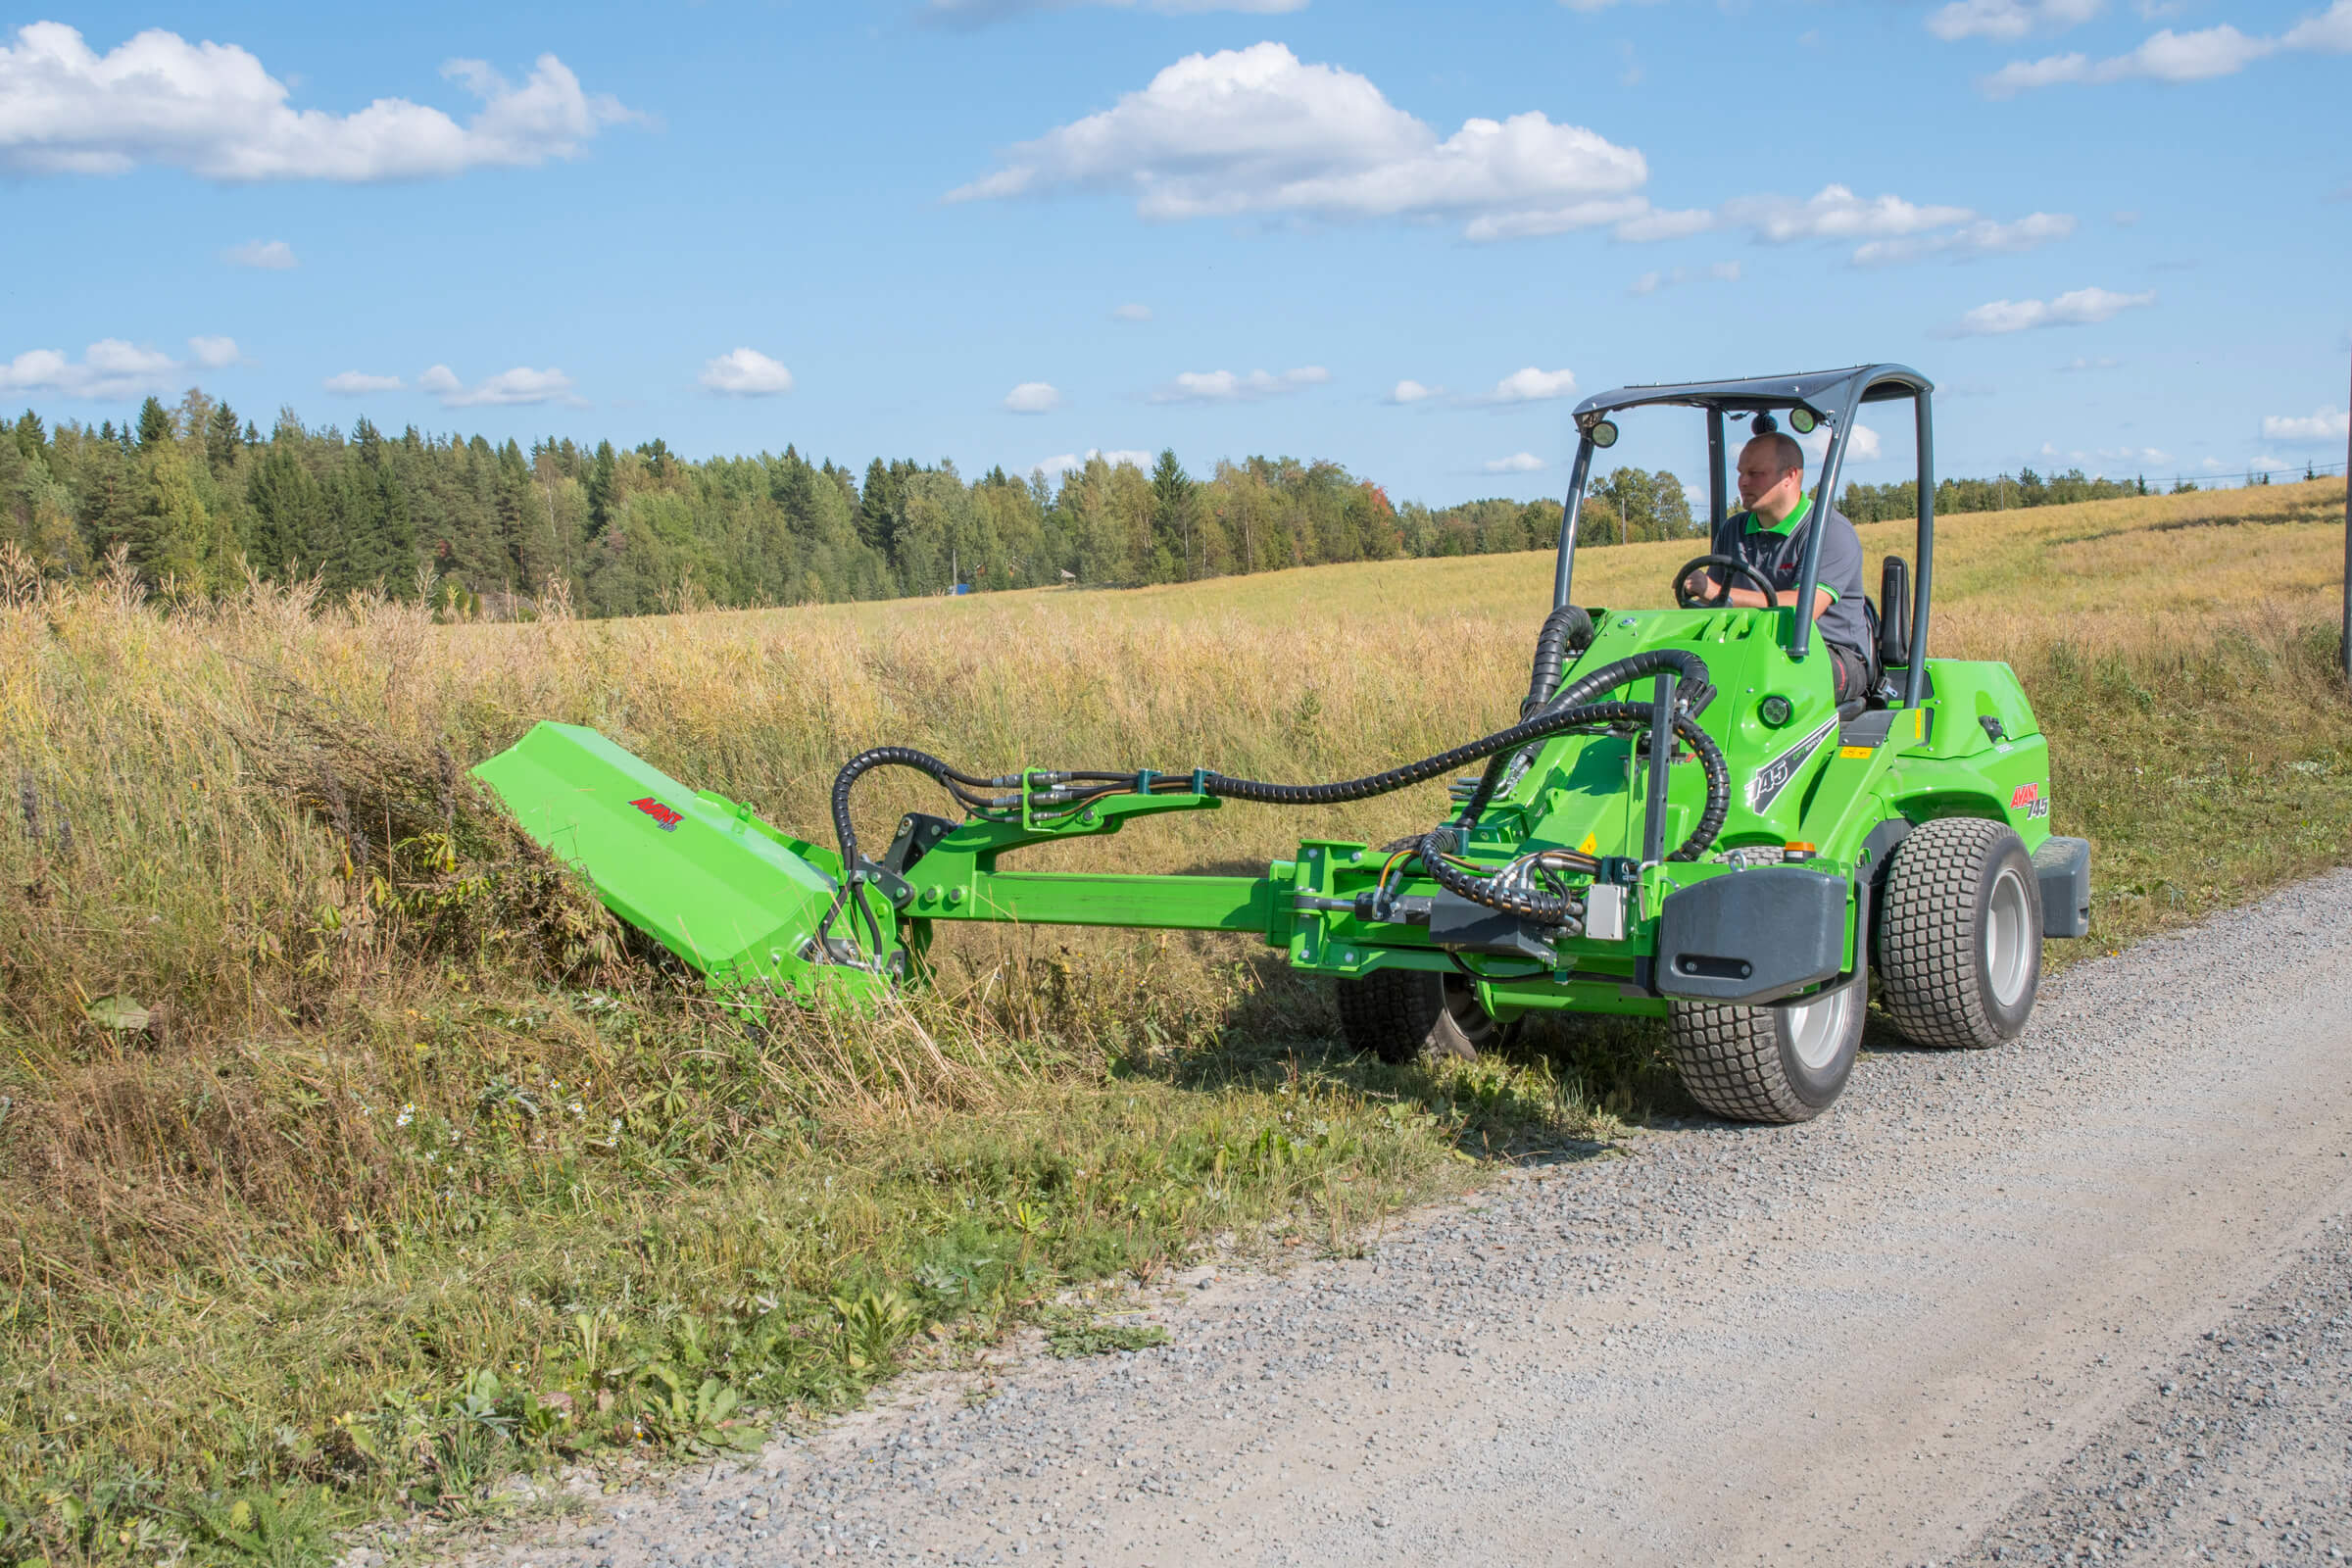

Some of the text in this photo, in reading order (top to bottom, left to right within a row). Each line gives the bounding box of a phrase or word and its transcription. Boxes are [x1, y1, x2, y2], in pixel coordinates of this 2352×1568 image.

[1744, 760, 1788, 807] 745
[2010, 782, 2038, 809] AVANT
[627, 797, 684, 825] AVANT
[2027, 797, 2048, 820] 745
